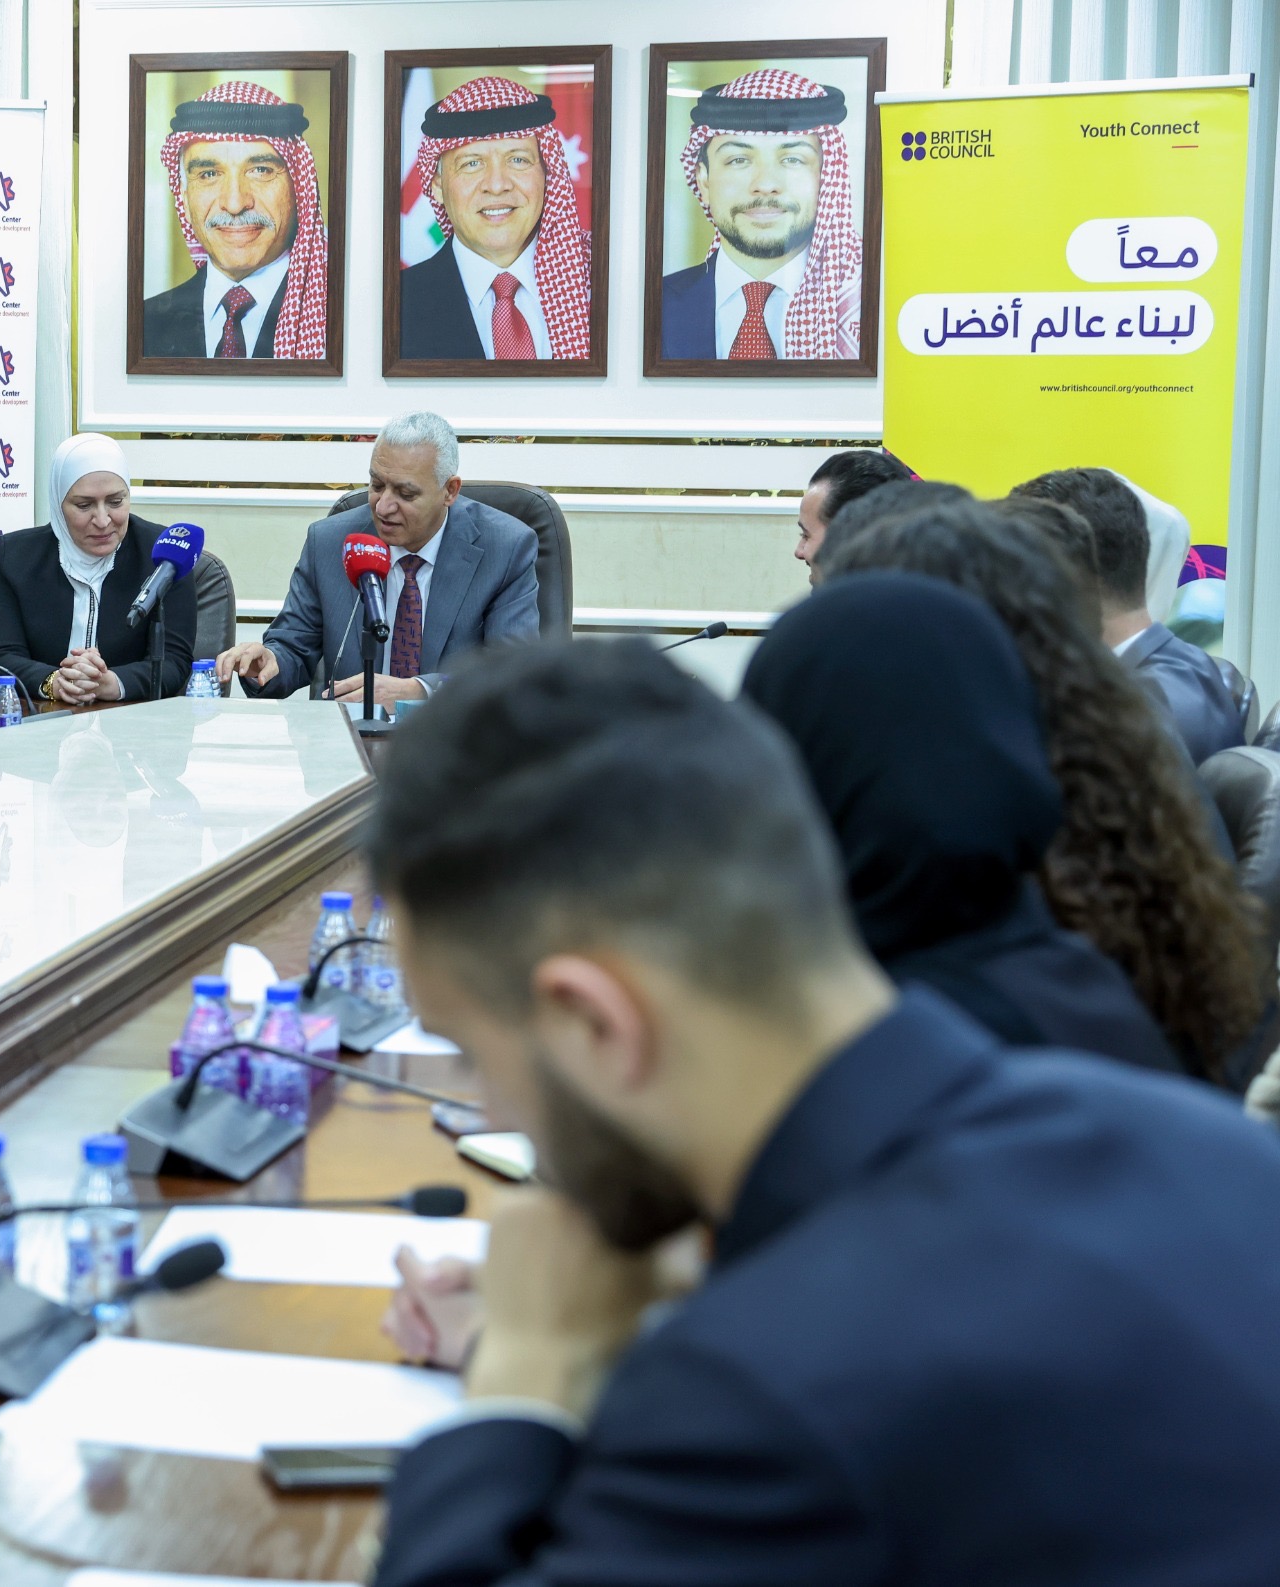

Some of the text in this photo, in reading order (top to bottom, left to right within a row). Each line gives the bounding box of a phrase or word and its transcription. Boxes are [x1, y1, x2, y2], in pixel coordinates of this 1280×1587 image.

[931, 129, 992, 145] BRITISH
[1080, 120, 1200, 138] Youth Connect
[930, 144, 995, 160] COUNCIL
[1117, 225, 1199, 269] معاً
[924, 298, 1196, 353] لبناء عالم أفضل
[1040, 384, 1194, 394] www.britishcouncil.org/youthconnect
